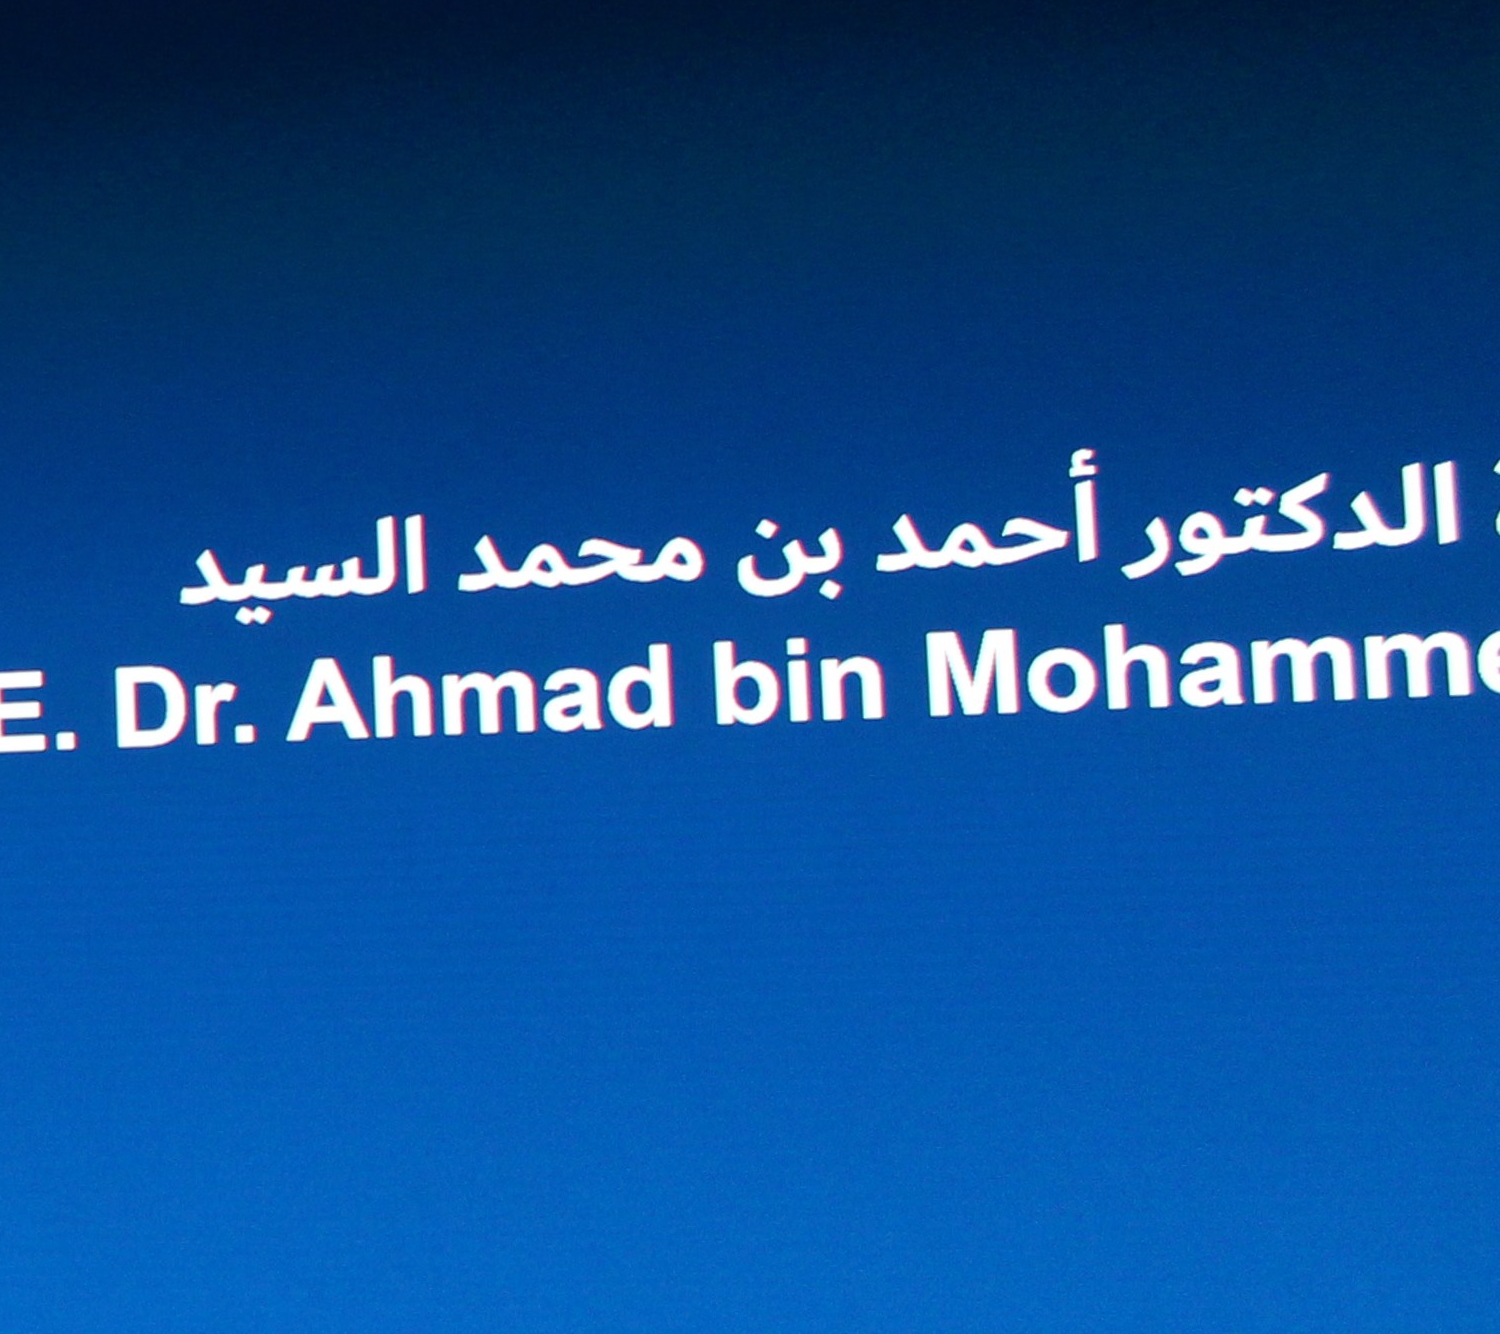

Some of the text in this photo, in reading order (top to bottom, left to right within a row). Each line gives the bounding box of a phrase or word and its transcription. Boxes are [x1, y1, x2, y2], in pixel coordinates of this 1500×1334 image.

[458, 534, 707, 592] محمد
[737, 518, 845, 600] بن
[876, 448, 1100, 572] أحمد
[1121, 460, 1461, 580] الدكتور
[179, 514, 428, 625] السيد
[115, 665, 258, 749] Dr.
[286, 642, 676, 742] Ahmad
[713, 637, 887, 726] bin
